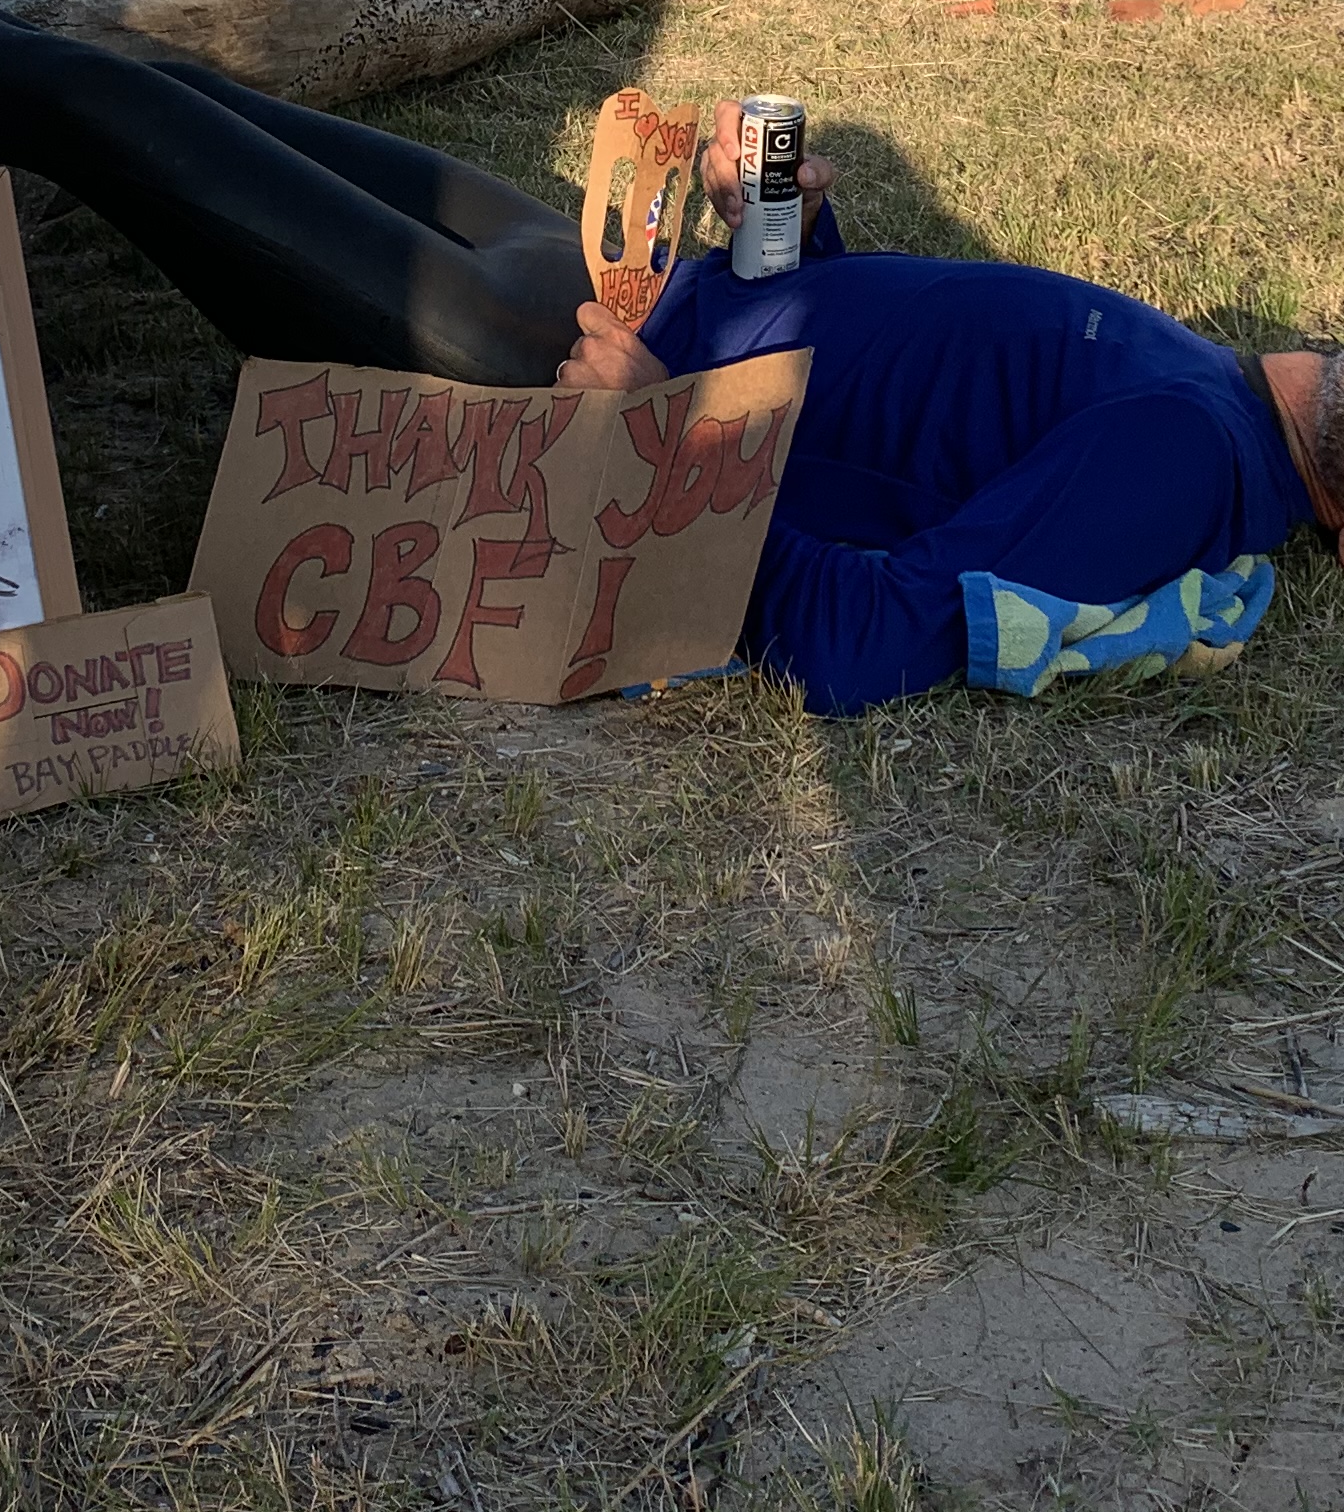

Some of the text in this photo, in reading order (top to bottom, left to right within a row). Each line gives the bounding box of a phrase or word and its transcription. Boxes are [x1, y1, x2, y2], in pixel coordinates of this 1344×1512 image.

[614, 92, 699, 166] I YOU
[741, 125, 758, 206] FITAID
[256, 368, 584, 572] THANK
[4, 750, 79, 797] BAY
